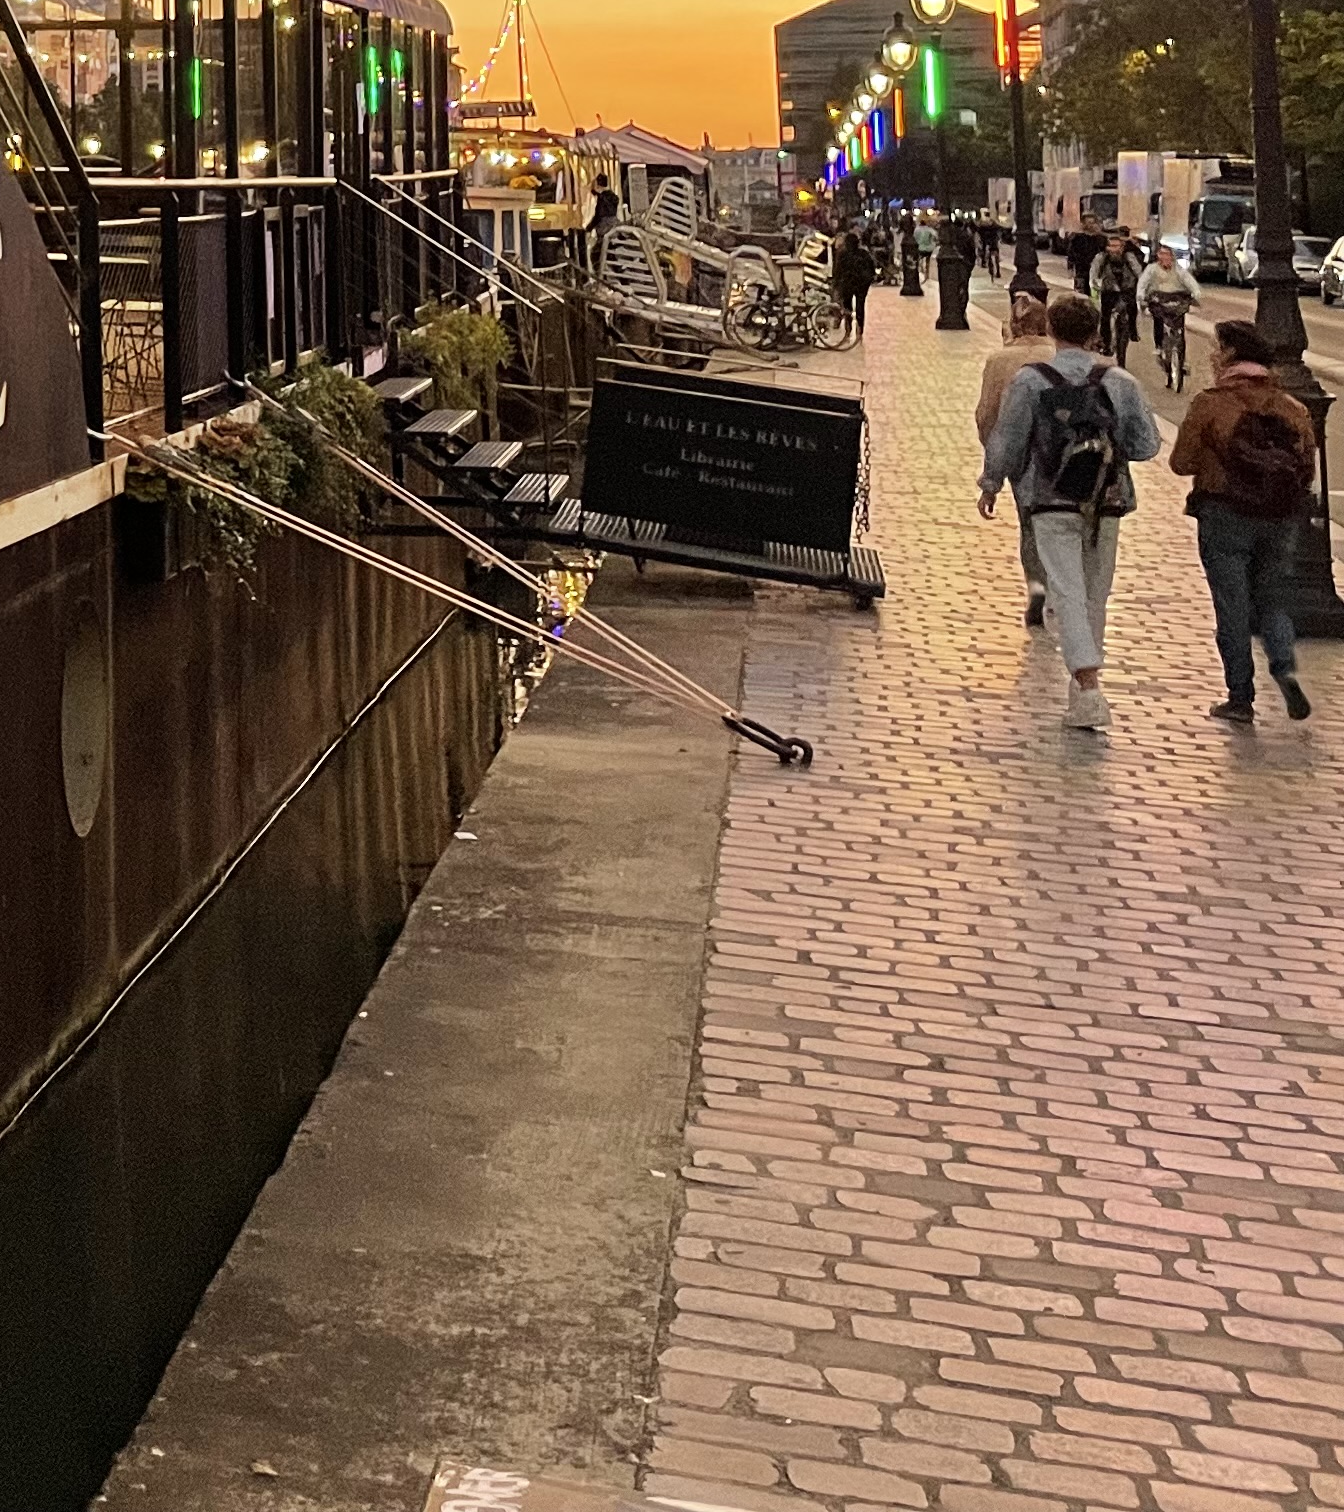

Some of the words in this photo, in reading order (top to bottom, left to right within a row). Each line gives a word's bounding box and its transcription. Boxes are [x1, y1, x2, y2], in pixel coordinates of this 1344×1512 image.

[685, 418, 710, 436] ET
[716, 422, 751, 442] LES
[680, 446, 755, 472] Librairie
[698, 470, 795, 497] Restaurant
